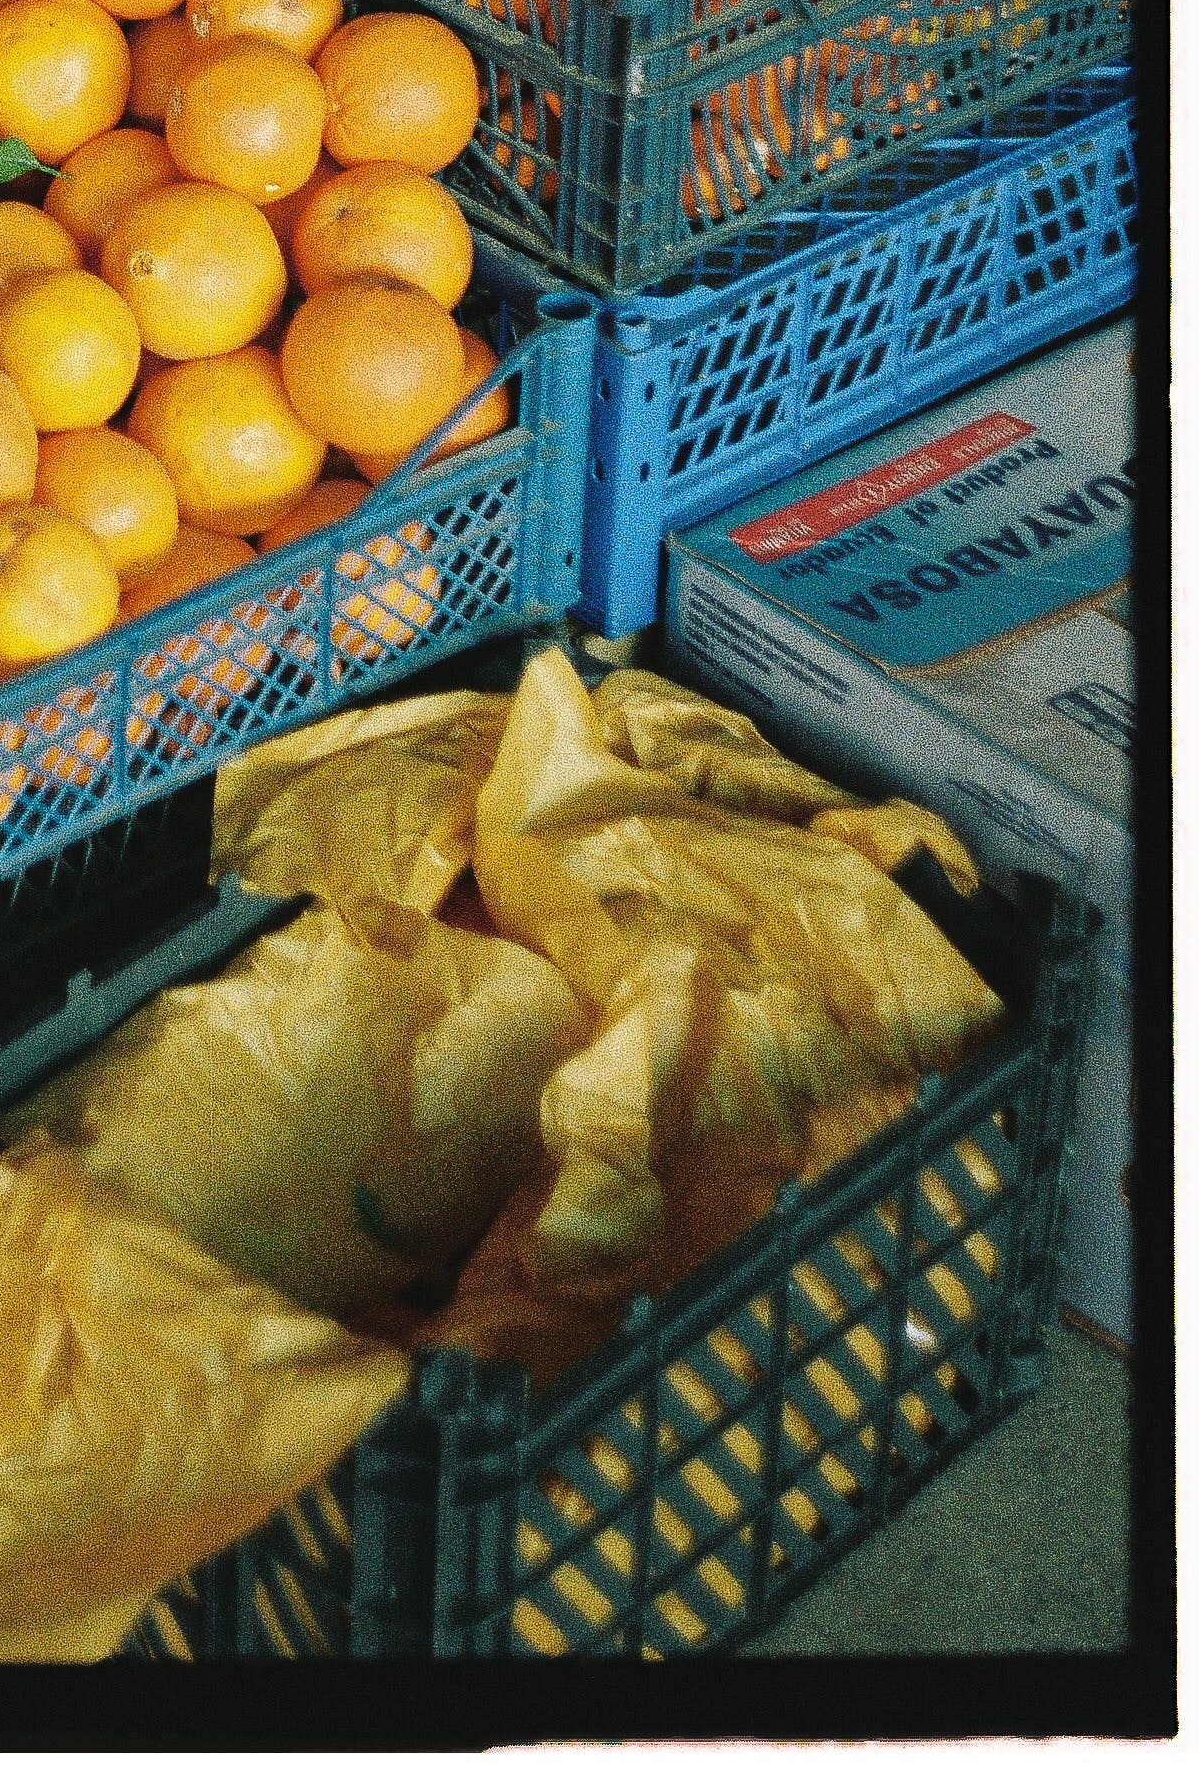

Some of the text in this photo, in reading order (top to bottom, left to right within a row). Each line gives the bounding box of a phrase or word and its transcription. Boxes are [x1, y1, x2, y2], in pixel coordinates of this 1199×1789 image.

[779, 438, 1061, 581] Product of Ecuador
[828, 457, 1138, 623] UAYABOSA
